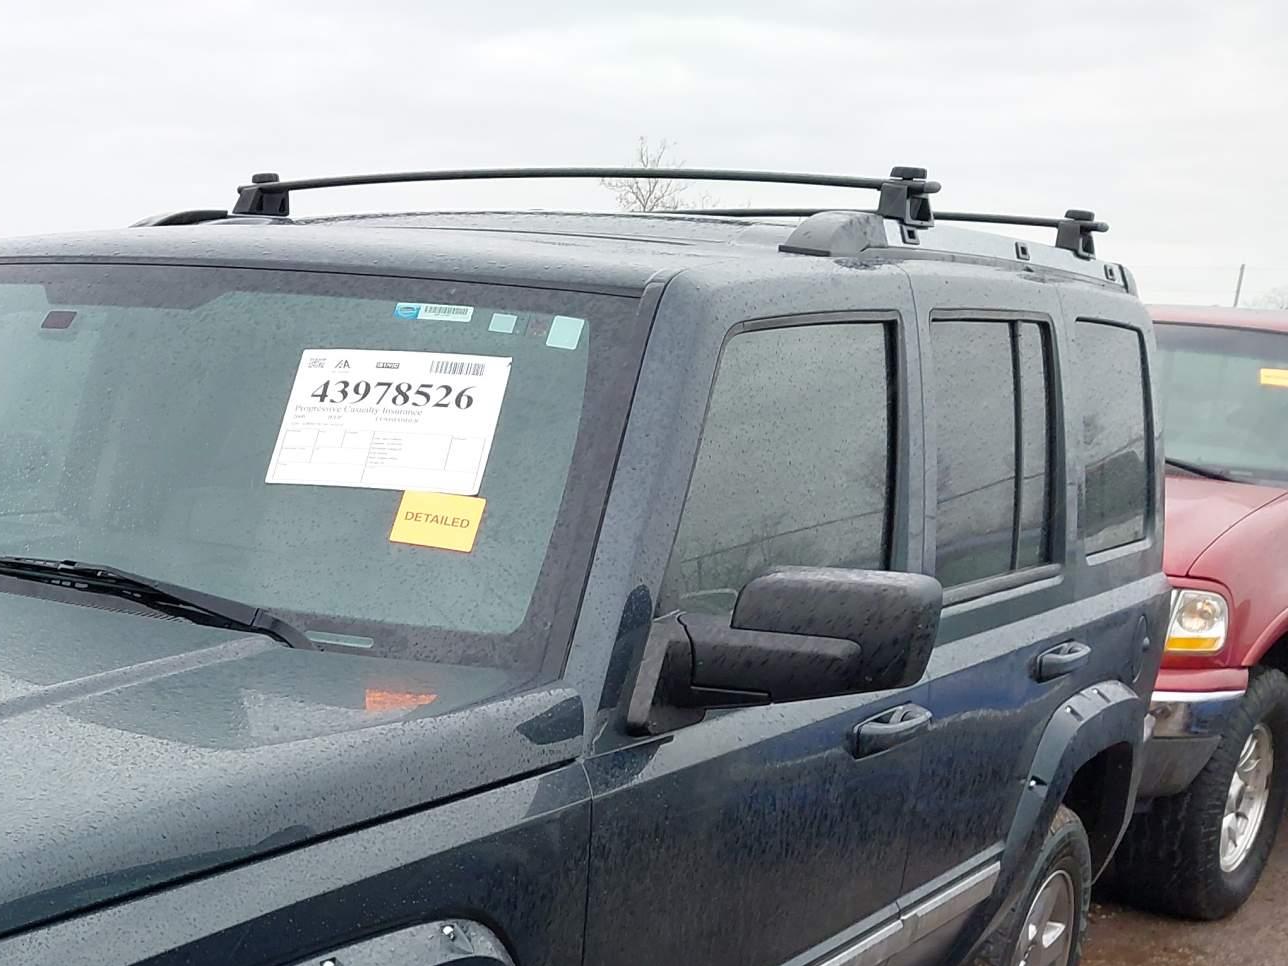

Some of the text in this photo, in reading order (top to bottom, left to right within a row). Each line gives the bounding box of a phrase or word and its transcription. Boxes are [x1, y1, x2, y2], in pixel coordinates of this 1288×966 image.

[310, 379, 476, 410] 43978526
[382, 406, 423, 417] Insurance
[404, 511, 470, 529] DETAILED
